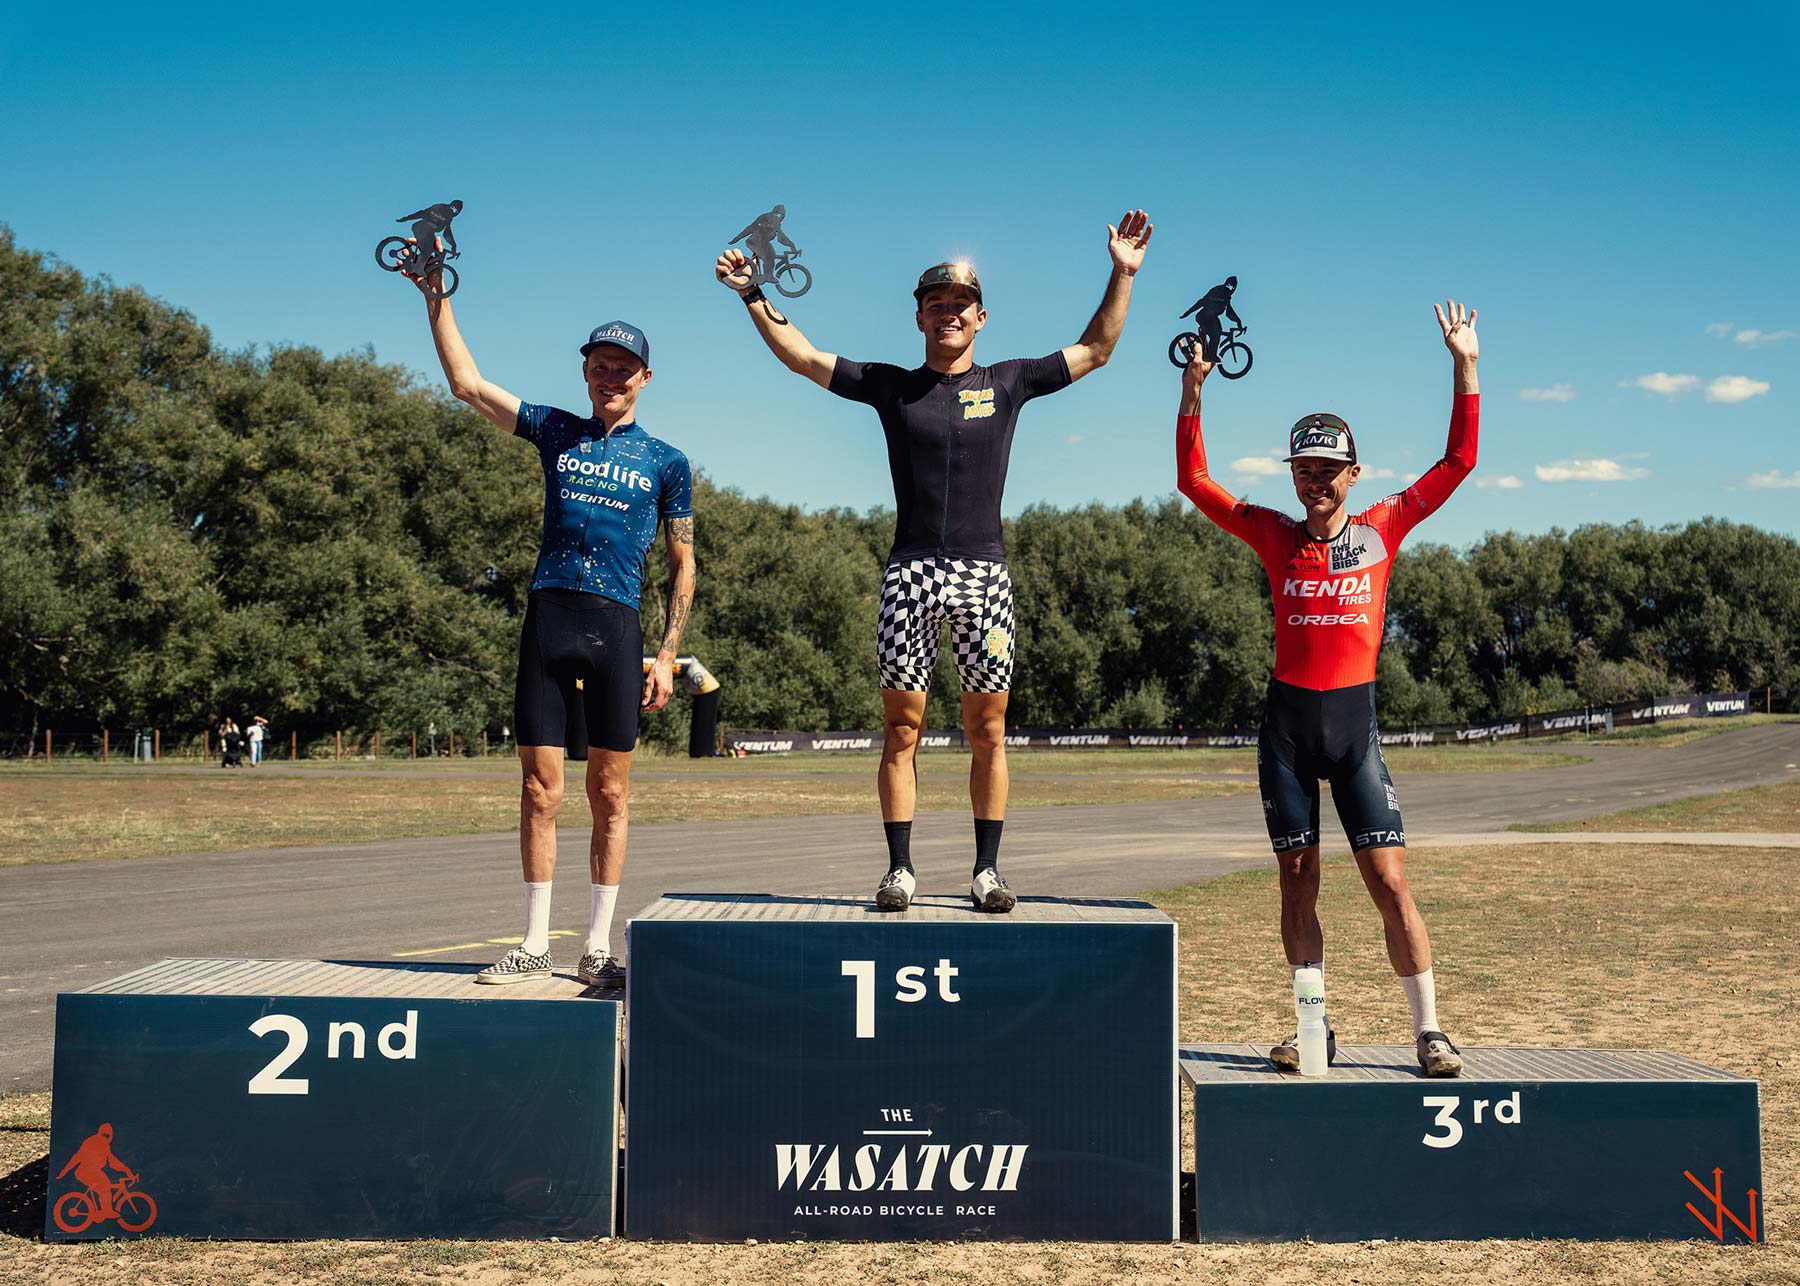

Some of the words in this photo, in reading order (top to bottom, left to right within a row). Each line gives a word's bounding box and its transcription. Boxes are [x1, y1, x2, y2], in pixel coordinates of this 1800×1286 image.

[1303, 435, 1333, 446] KASK
[567, 475, 618, 491] RACNG
[1331, 543, 1351, 554] THE
[1332, 543, 1368, 562] BLACK
[1332, 557, 1360, 570] BIBS
[1282, 572, 1372, 598] KENDA
[1338, 594, 1372, 606] TIRES
[1287, 613, 1370, 626] ORBEA
[1632, 703, 1691, 719] VENTUM
[812, 738, 872, 750] VENTUM
[1049, 735, 1110, 746] VENTUM
[1129, 735, 1189, 746] VENTUM
[1380, 731, 1435, 744] ENTUM
[841, 958, 961, 1038] 1st
[248, 1010, 419, 1095] 2nd
[880, 1108, 914, 1122] THE
[1422, 1091, 1522, 1149] 3rd
[775, 1143, 1029, 1192] WASATCH
[793, 1205, 873, 1216] ALL-ROAD
[879, 1205, 945, 1216] BICYCLE
[956, 1205, 997, 1216] RACE
